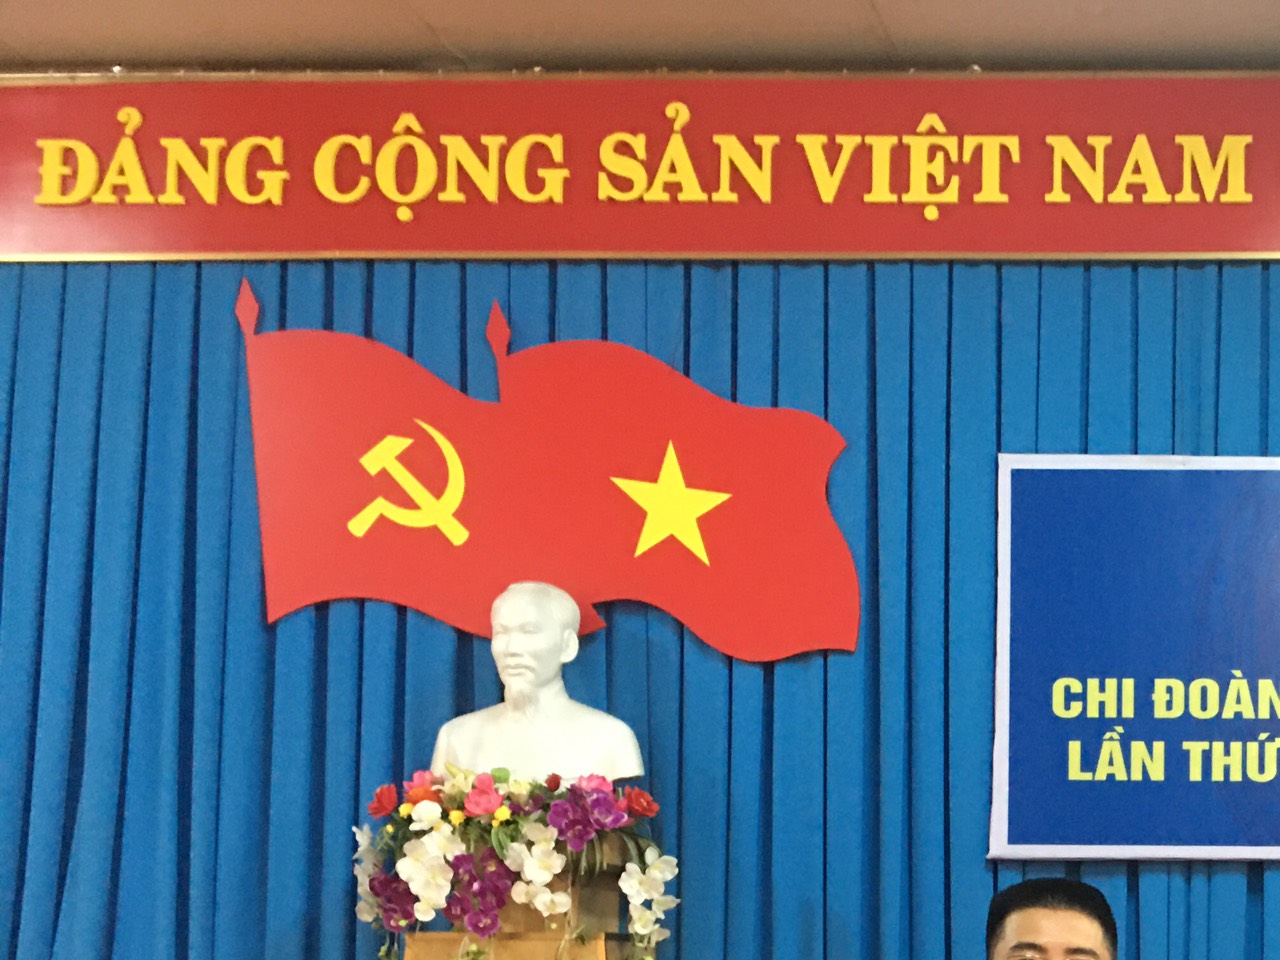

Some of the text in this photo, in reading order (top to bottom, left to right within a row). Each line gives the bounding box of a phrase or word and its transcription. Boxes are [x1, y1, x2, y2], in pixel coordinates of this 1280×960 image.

[34, 106, 289, 206] ĐẢNG
[313, 112, 570, 222] CỘNG
[597, 101, 780, 204] SẢN
[796, 112, 1021, 221] VIỆT
[1045, 133, 1253, 204] NAM
[1052, 677, 1135, 719] CHI
[1068, 726, 1165, 781] LẦN
